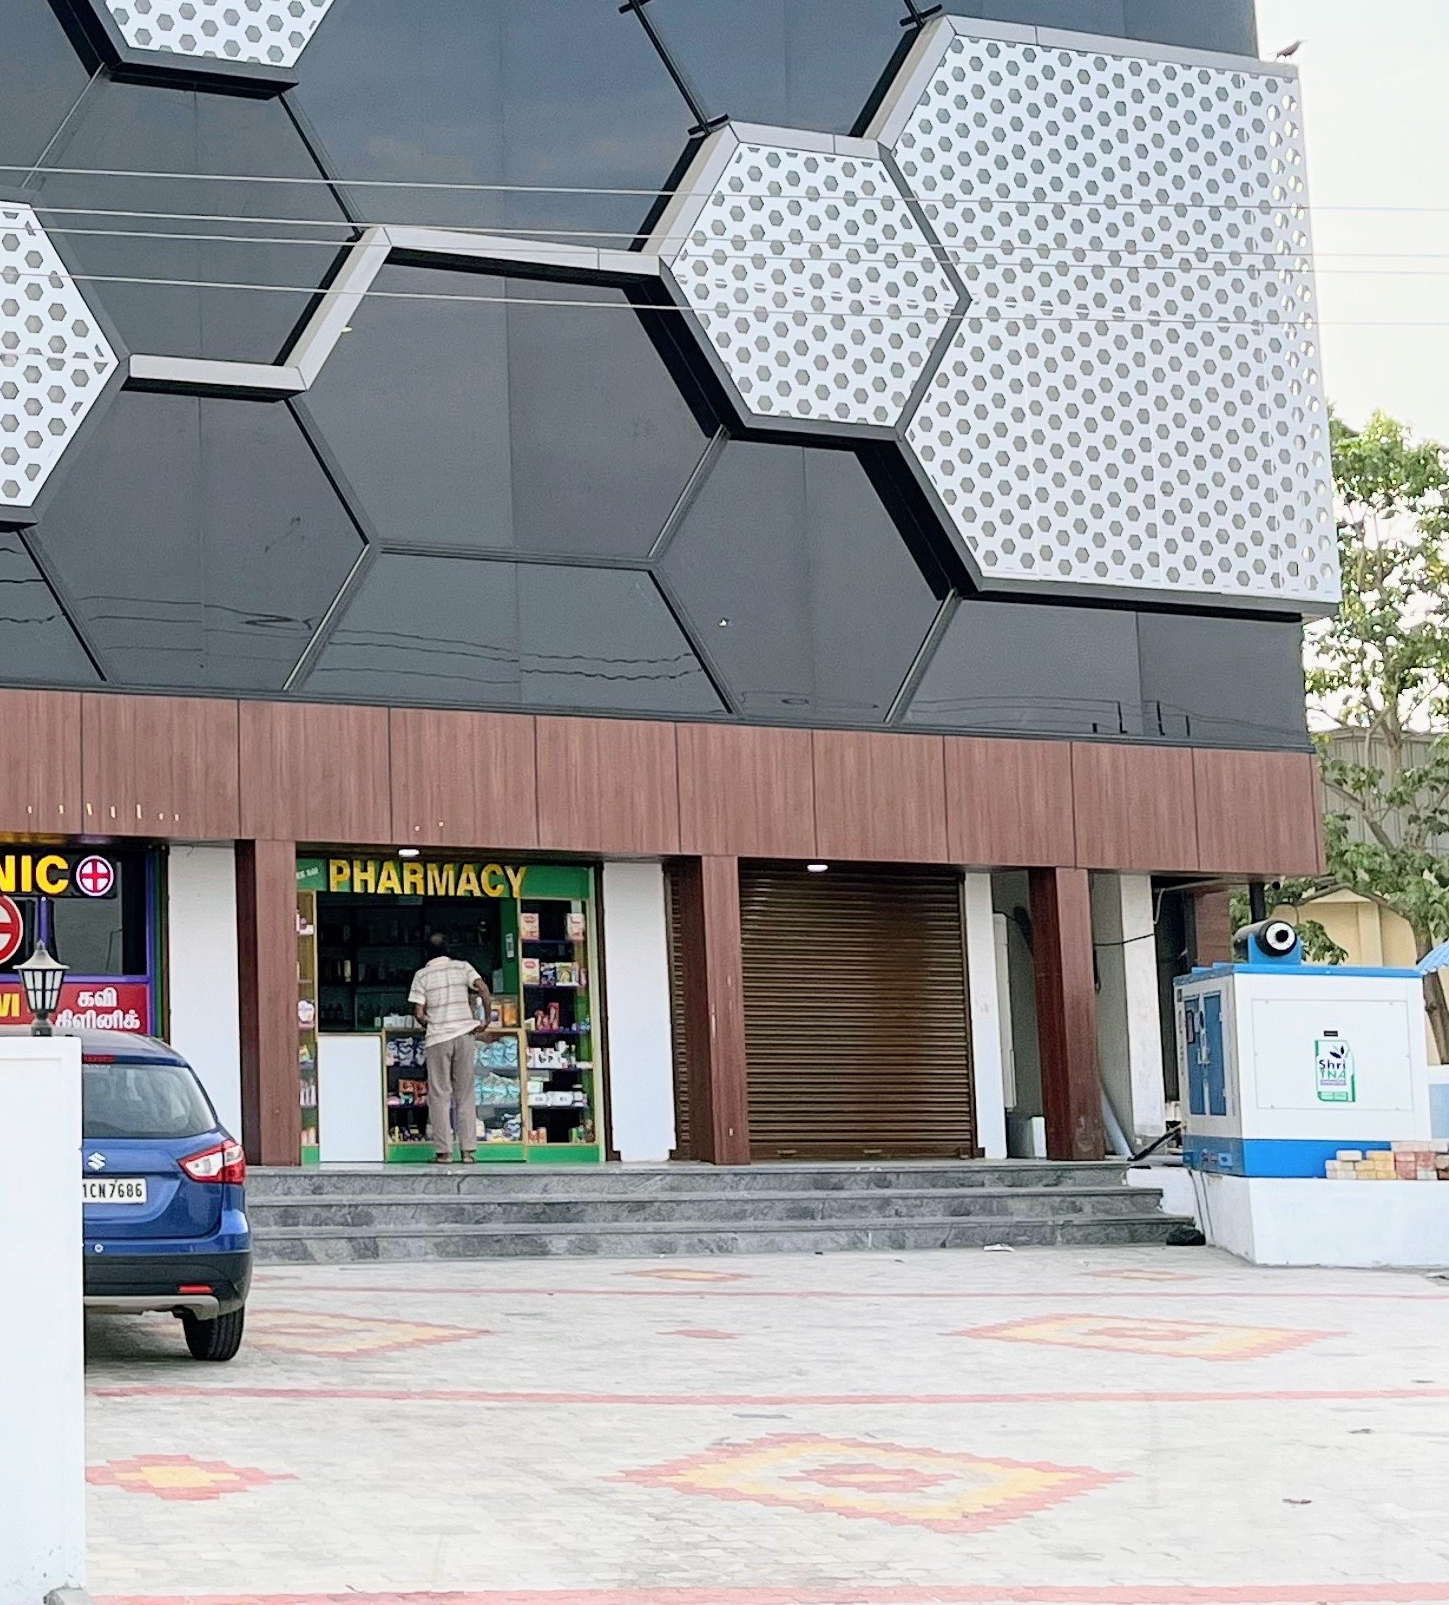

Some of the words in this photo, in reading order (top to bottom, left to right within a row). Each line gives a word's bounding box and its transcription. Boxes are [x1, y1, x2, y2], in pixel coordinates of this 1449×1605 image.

[329, 858, 527, 899] PHARMACY
[77, 987, 118, 1008] கவி
[1318, 1058, 1346, 1070] Shri
